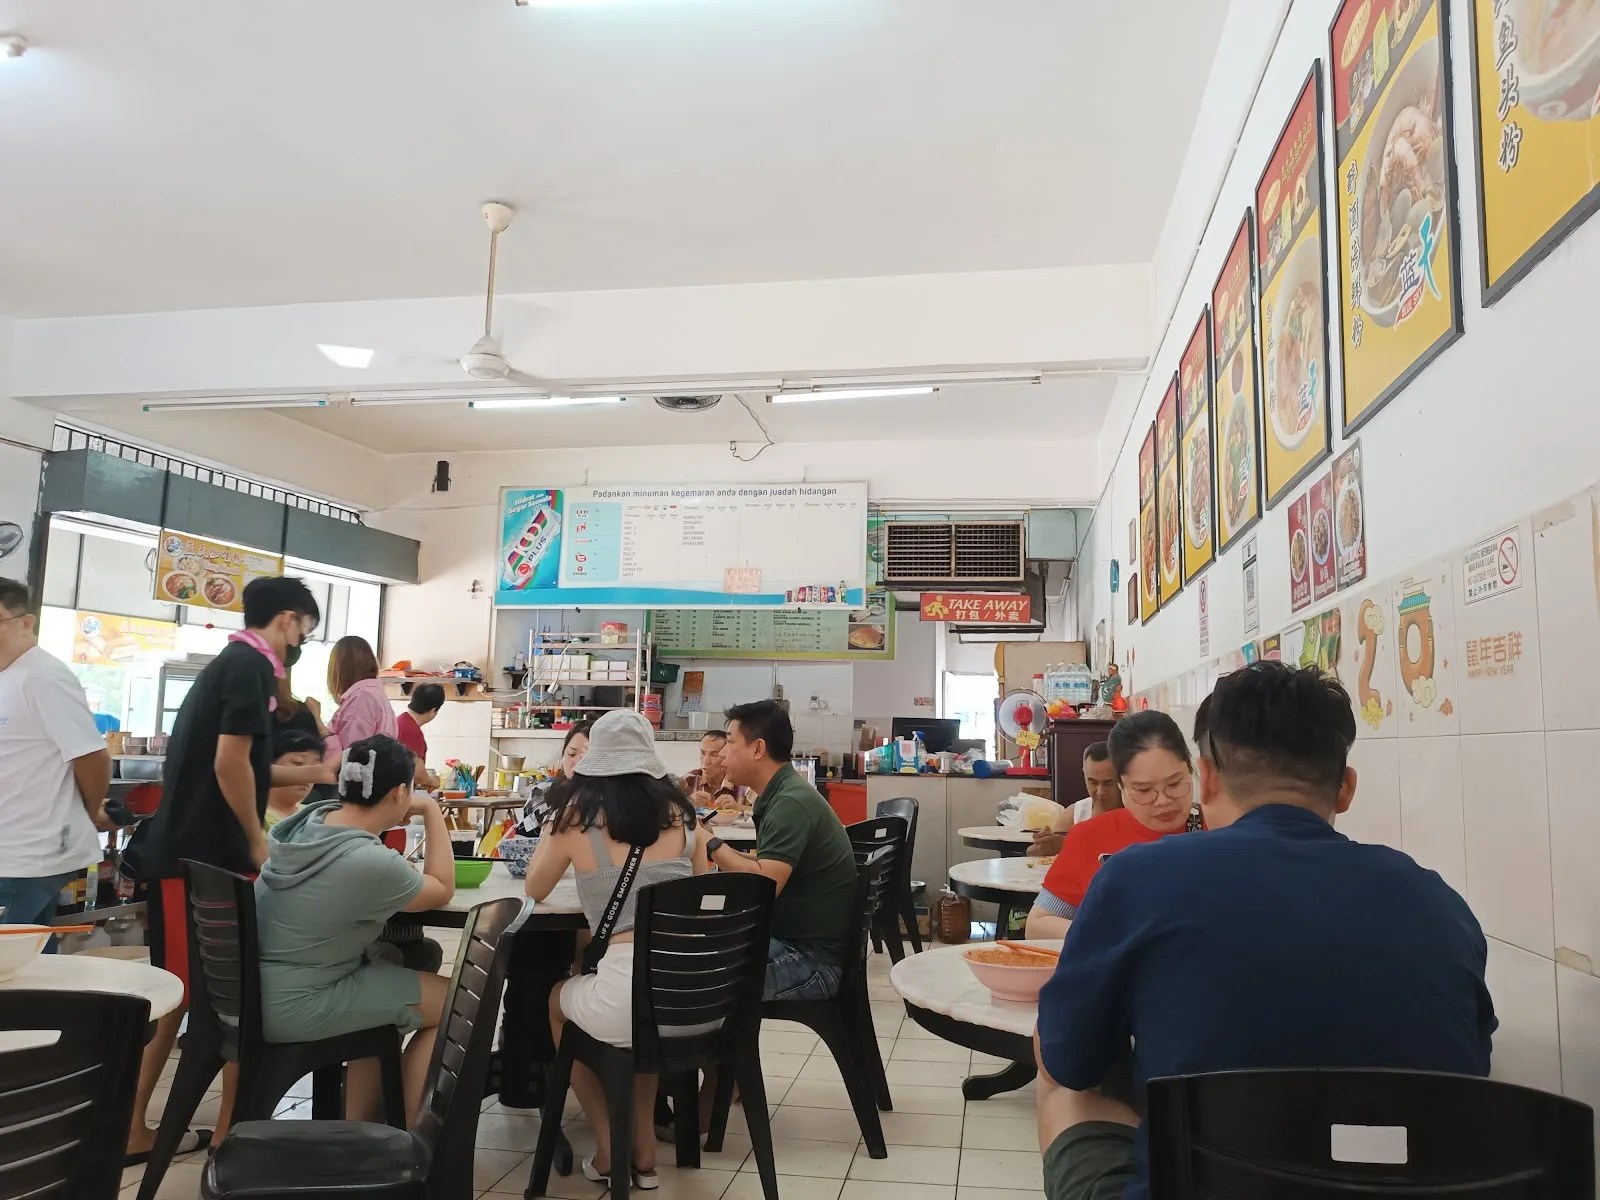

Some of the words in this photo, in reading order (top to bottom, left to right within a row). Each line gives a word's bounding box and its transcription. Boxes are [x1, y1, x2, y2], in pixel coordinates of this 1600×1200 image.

[1400, 299, 1412, 318] BLUE
[1412, 284, 1424, 304] SKY
[592, 489, 631, 498] Padankan
[633, 489, 669, 498] minuman
[671, 489, 715, 499] kegemaran
[717, 488, 736, 497] anda
[738, 488, 768, 498] dengan
[769, 487, 797, 498] juadah
[799, 487, 837, 497] hidangan
[528, 536, 547, 562] PLUS
[948, 599, 982, 610] TAKE
[983, 600, 1028, 611] AWAY
[955, 610, 979, 620] 打包
[994, 610, 1020, 621] 外卖
[1468, 668, 1483, 679] HAPPY
[1486, 666, 1498, 677] NEW
[1500, 664, 1514, 675] YEAR
[599, 923, 610, 939] LIFE
[607, 901, 620, 921] GOES
[616, 856, 637, 899] SMOOTHER
